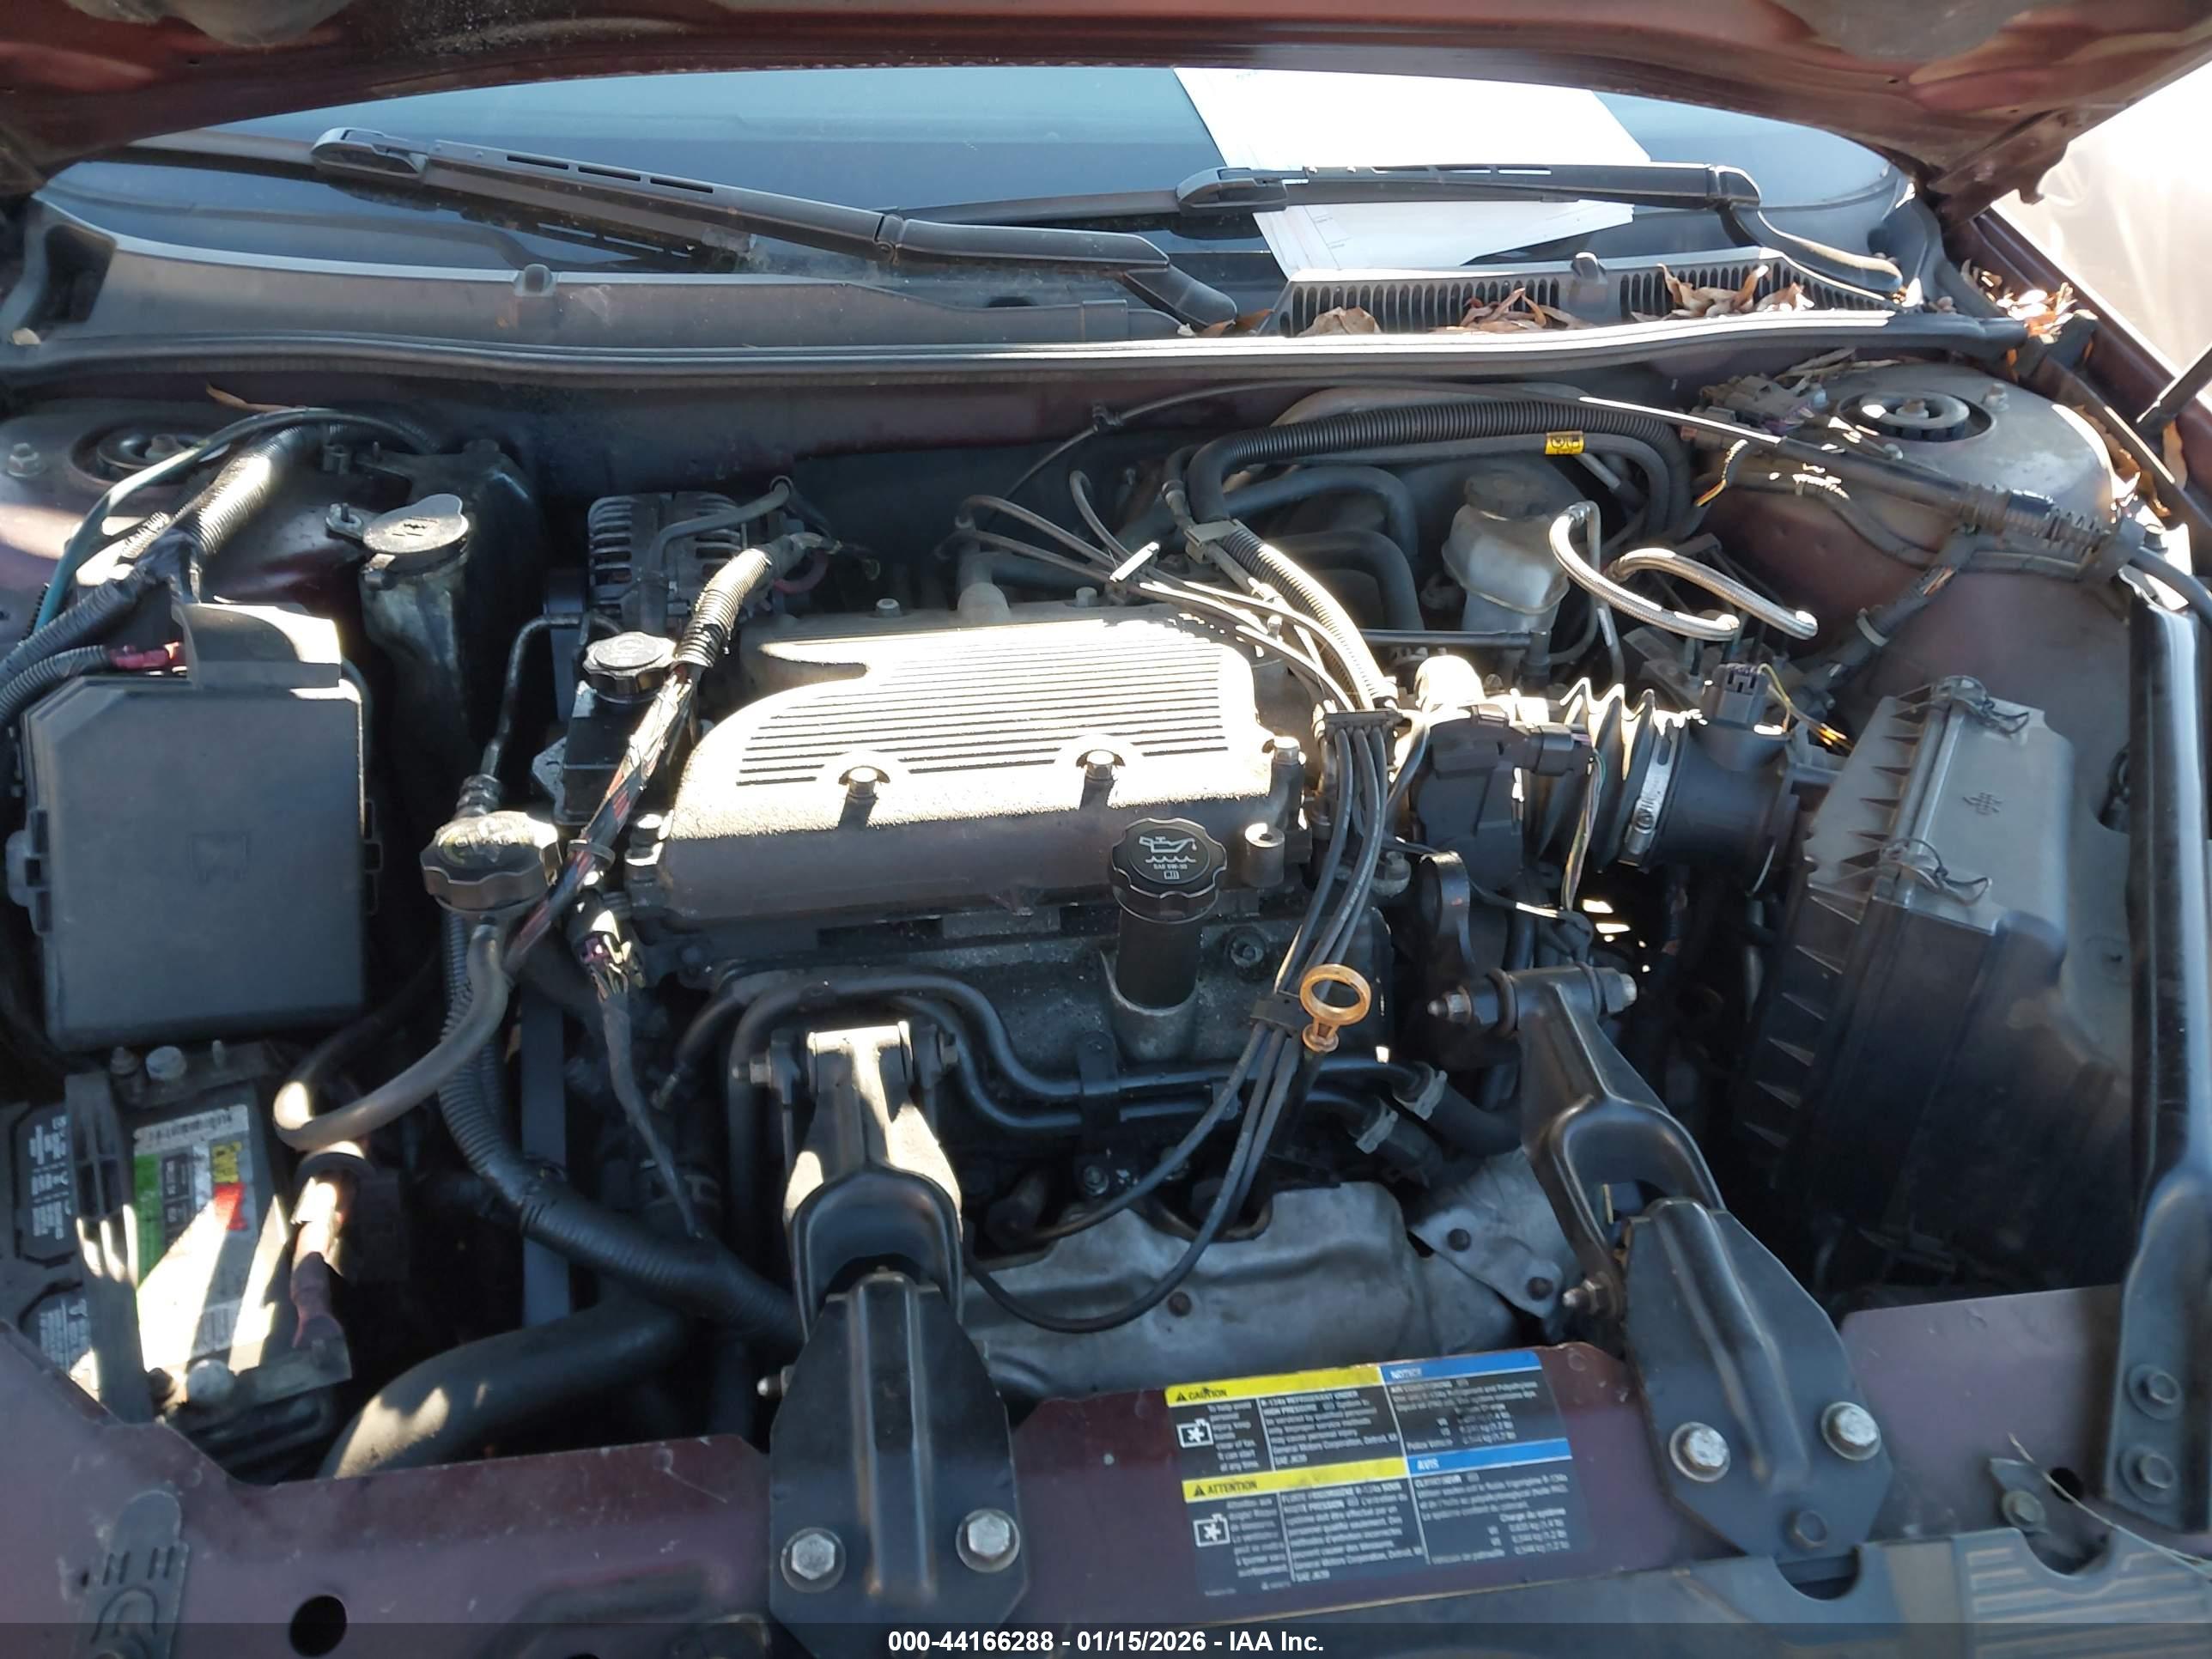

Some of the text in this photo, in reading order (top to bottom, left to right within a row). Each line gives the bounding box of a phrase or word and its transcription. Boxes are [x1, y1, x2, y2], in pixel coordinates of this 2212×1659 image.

[1188, 1389, 1227, 1400] CAUTION
[1416, 1458, 1439, 1470] AVIS
[1207, 1480, 1257, 1493] ATTENTION
